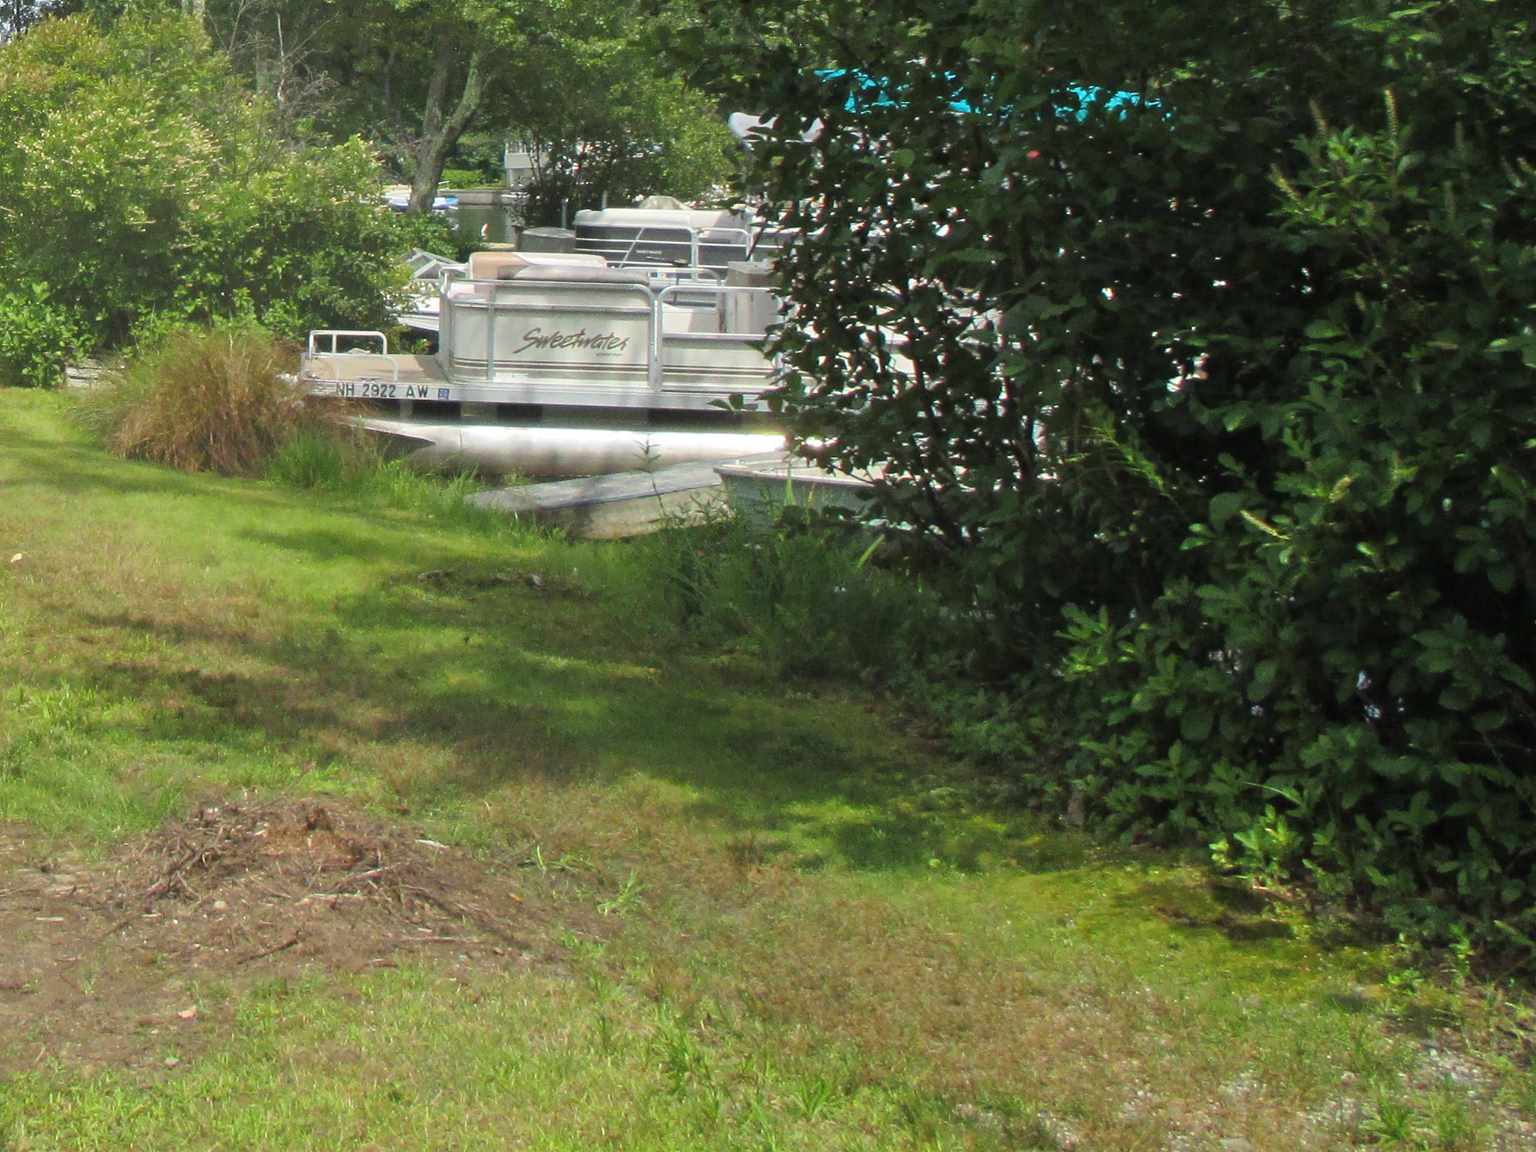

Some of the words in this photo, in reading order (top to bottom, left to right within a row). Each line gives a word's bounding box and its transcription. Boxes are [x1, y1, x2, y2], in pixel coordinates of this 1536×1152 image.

[512, 327, 631, 354] Sweetwater
[336, 382, 354, 396] NH
[362, 383, 396, 398] 2922
